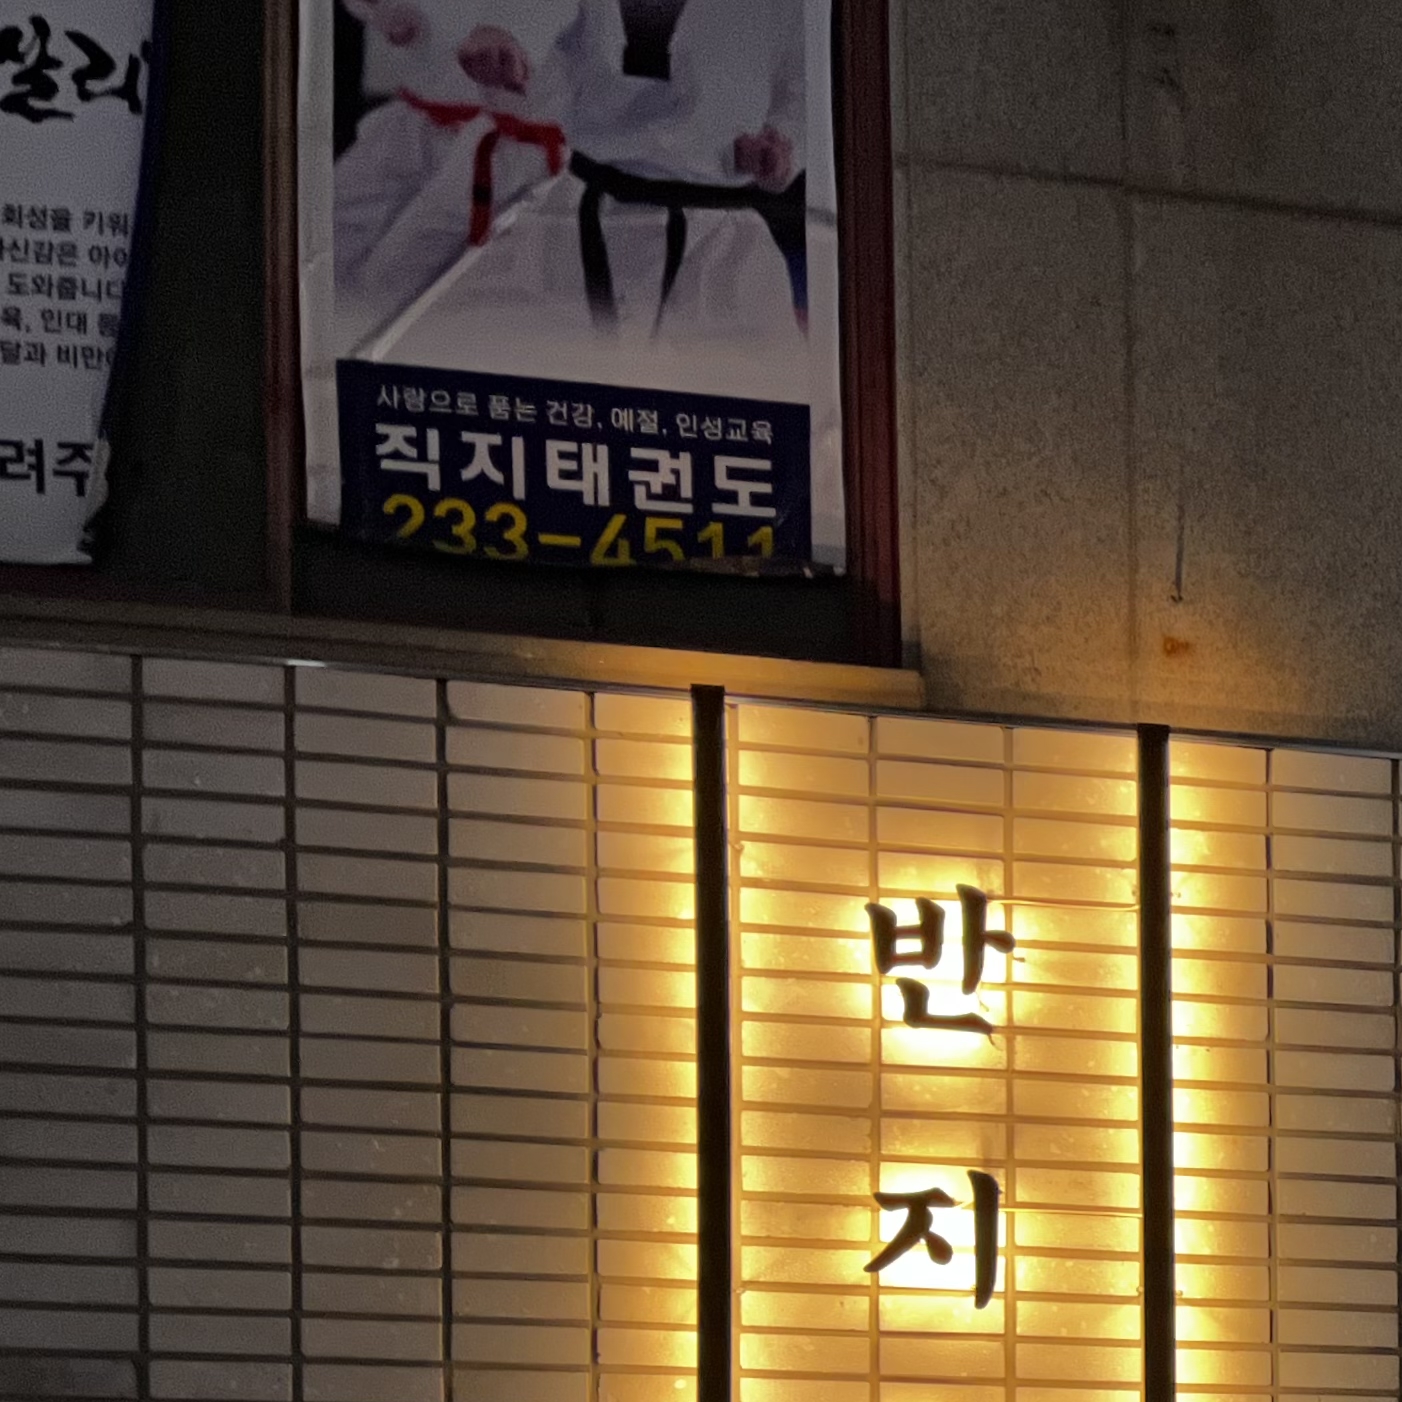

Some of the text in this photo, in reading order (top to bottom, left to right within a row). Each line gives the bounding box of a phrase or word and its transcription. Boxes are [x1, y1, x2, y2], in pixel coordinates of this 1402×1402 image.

[0, 237, 77, 268] 신감은
[377, 384, 480, 417] 사랑으로
[546, 399, 603, 430] 건강,
[610, 407, 668, 436] 예절,
[675, 412, 774, 445] 인성교육
[374, 422, 778, 519] 직지태권도
[382, 492, 777, 568] 233-4511
